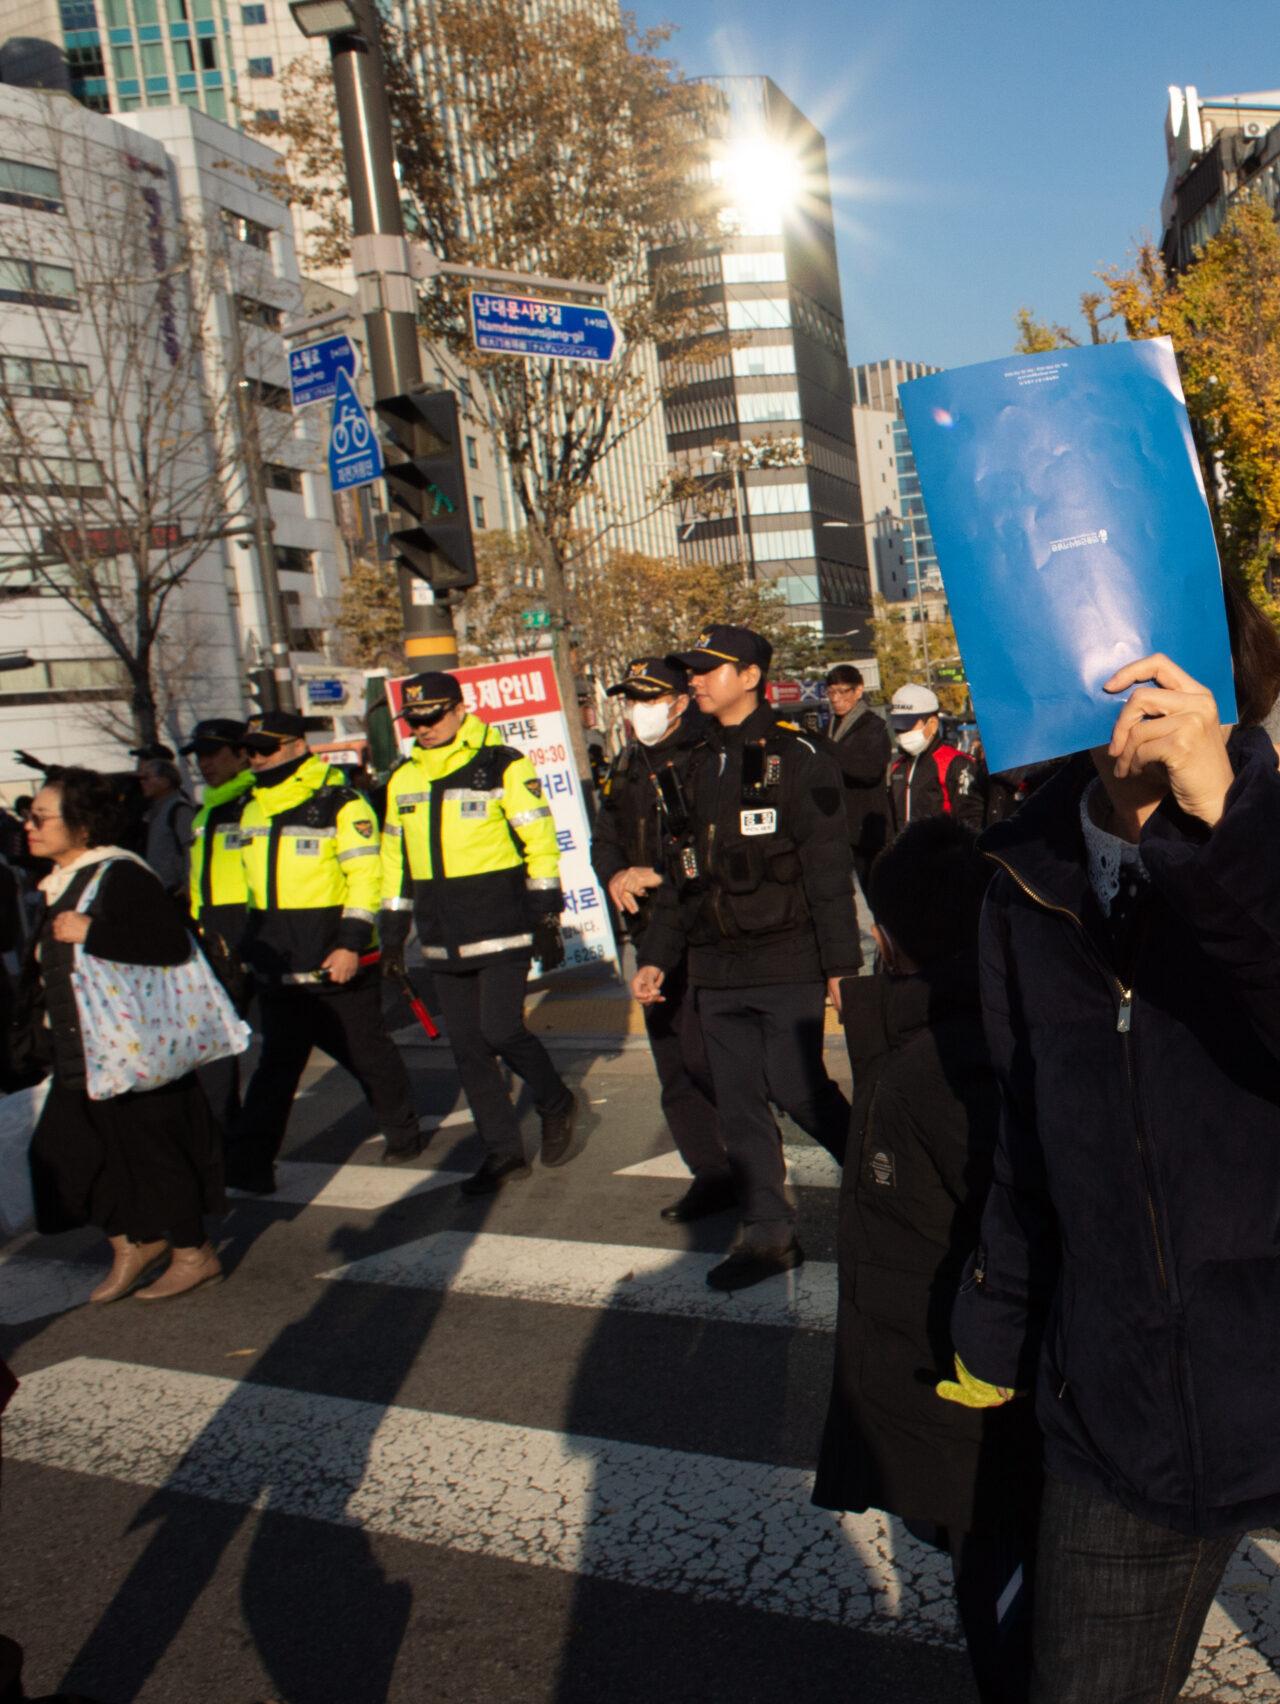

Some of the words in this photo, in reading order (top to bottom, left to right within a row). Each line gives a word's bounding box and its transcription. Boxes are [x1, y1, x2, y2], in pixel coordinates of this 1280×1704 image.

[475, 296, 562, 325] 남대문시장길
[477, 318, 585, 344] Namdaemunsijang-gil
[292, 349, 321, 370] 소월로
[529, 744, 566, 767] 09:30
